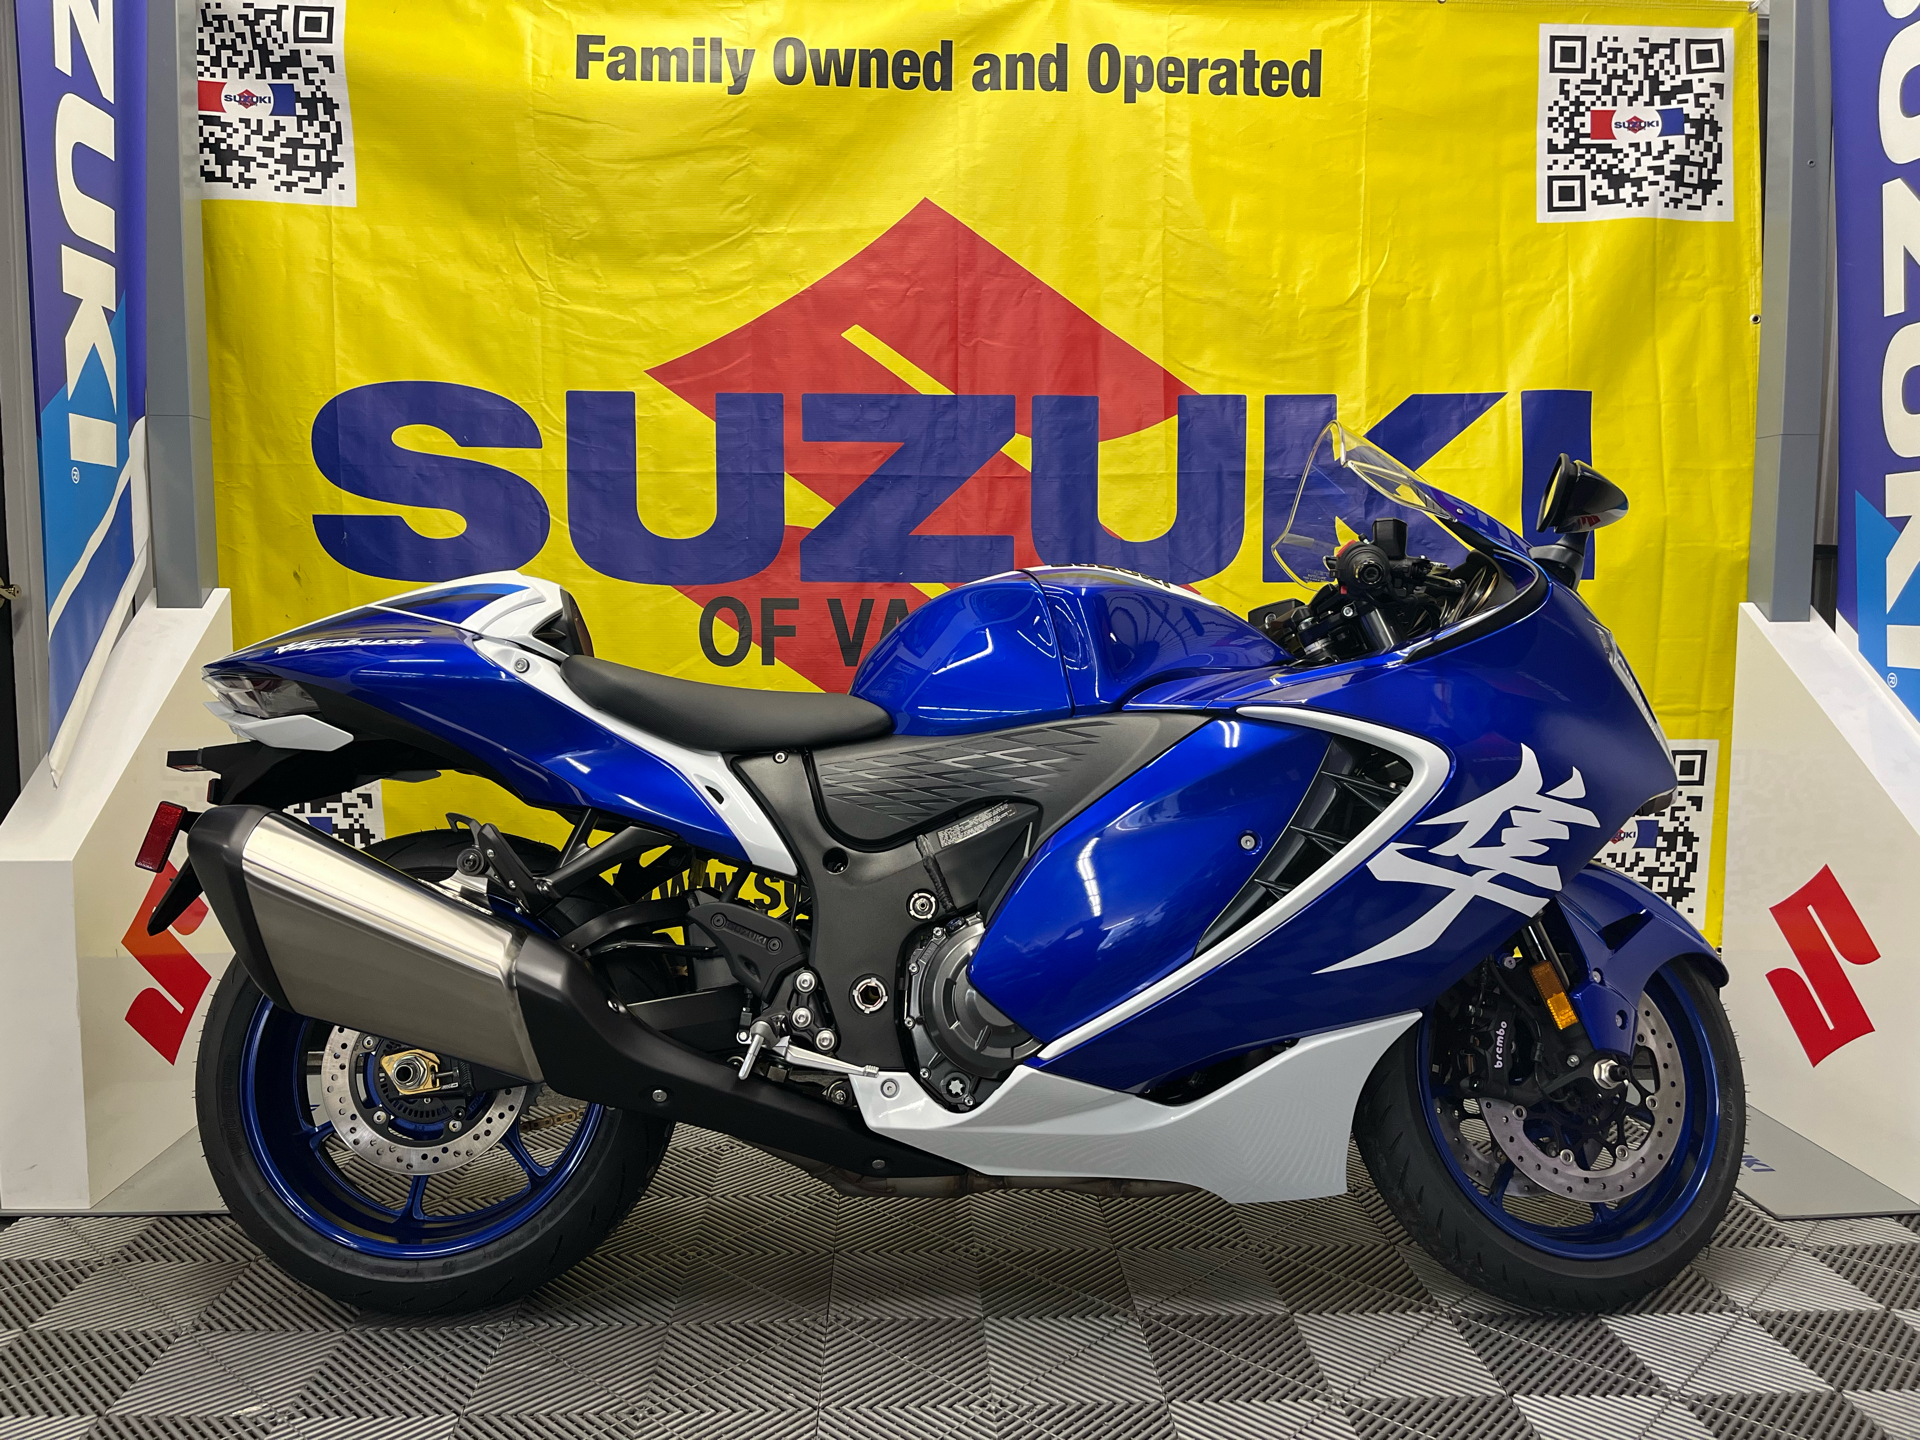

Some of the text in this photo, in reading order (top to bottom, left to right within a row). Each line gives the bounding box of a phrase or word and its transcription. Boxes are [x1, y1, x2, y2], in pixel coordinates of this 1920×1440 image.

[574, 35, 1322, 104] Family Owned and Operated
[223, 94, 272, 104] SUZUKI
[1614, 120, 1660, 130] SUZUKI
[312, 382, 1594, 585] SUZUKI
[699, 596, 800, 667] OF
[1313, 743, 1601, 974] 隼
[725, 922, 767, 945] SUZUKI
[1494, 1021, 1508, 1068] brembo
